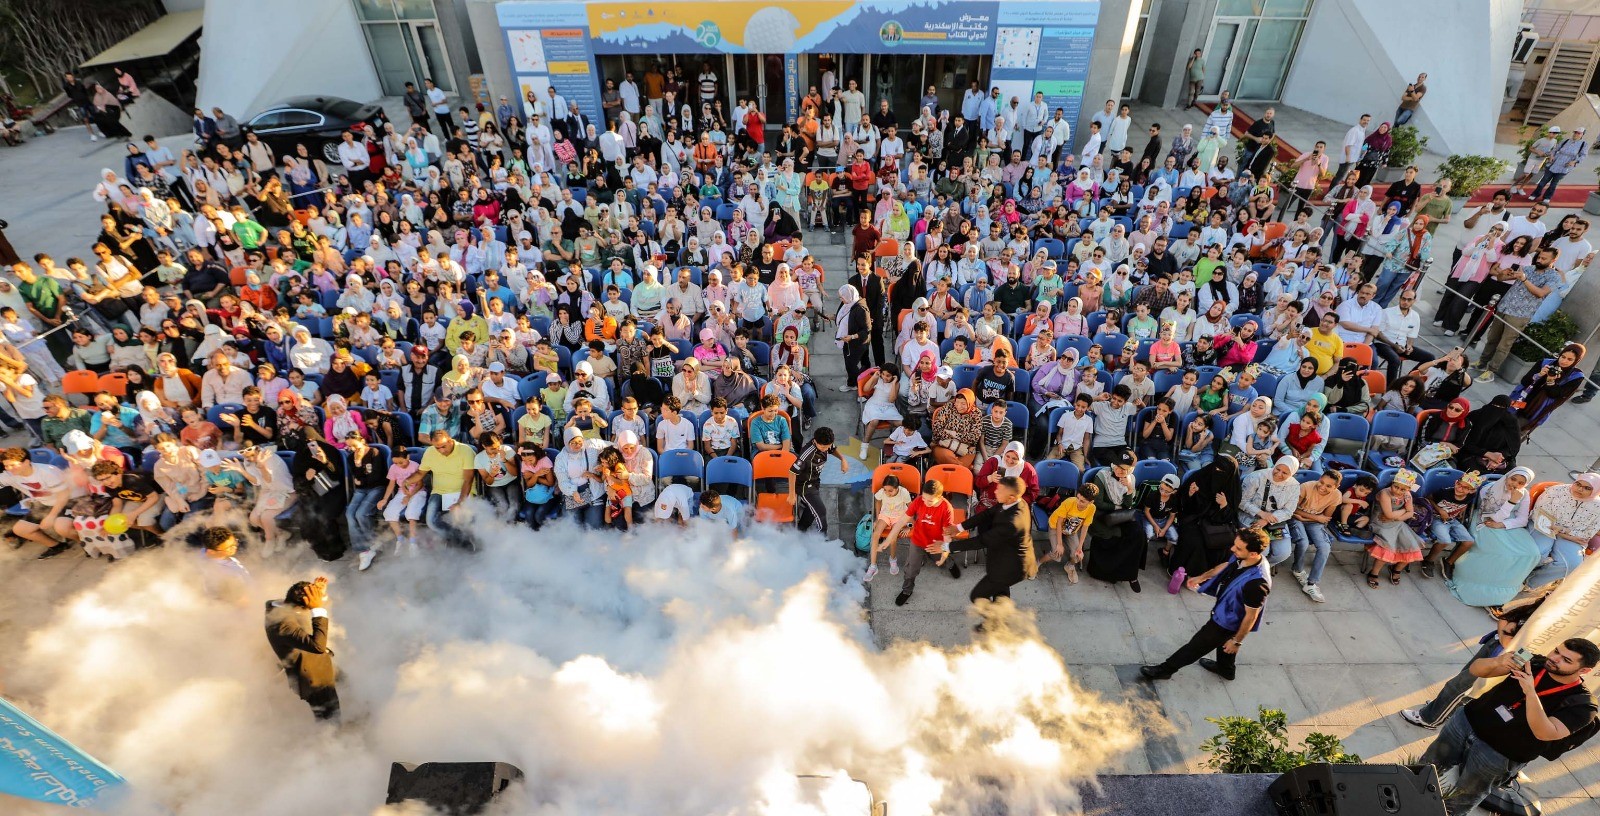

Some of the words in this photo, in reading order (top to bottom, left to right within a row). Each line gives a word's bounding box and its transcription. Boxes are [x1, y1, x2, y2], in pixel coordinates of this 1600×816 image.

[959, 13, 990, 22] معرض
[924, 22, 959, 31] الإسكندرية
[959, 22, 988, 31] مكتبة
[697, 24, 717, 47] 20
[948, 31, 968, 39] للكتاب
[968, 32, 988, 41] الدولي
[788, 58, 797, 75] جناح
[788, 75, 797, 96] الطفل
[983, 378, 1007, 390] CAUTION
[35, 737, 110, 792] lanetarium
